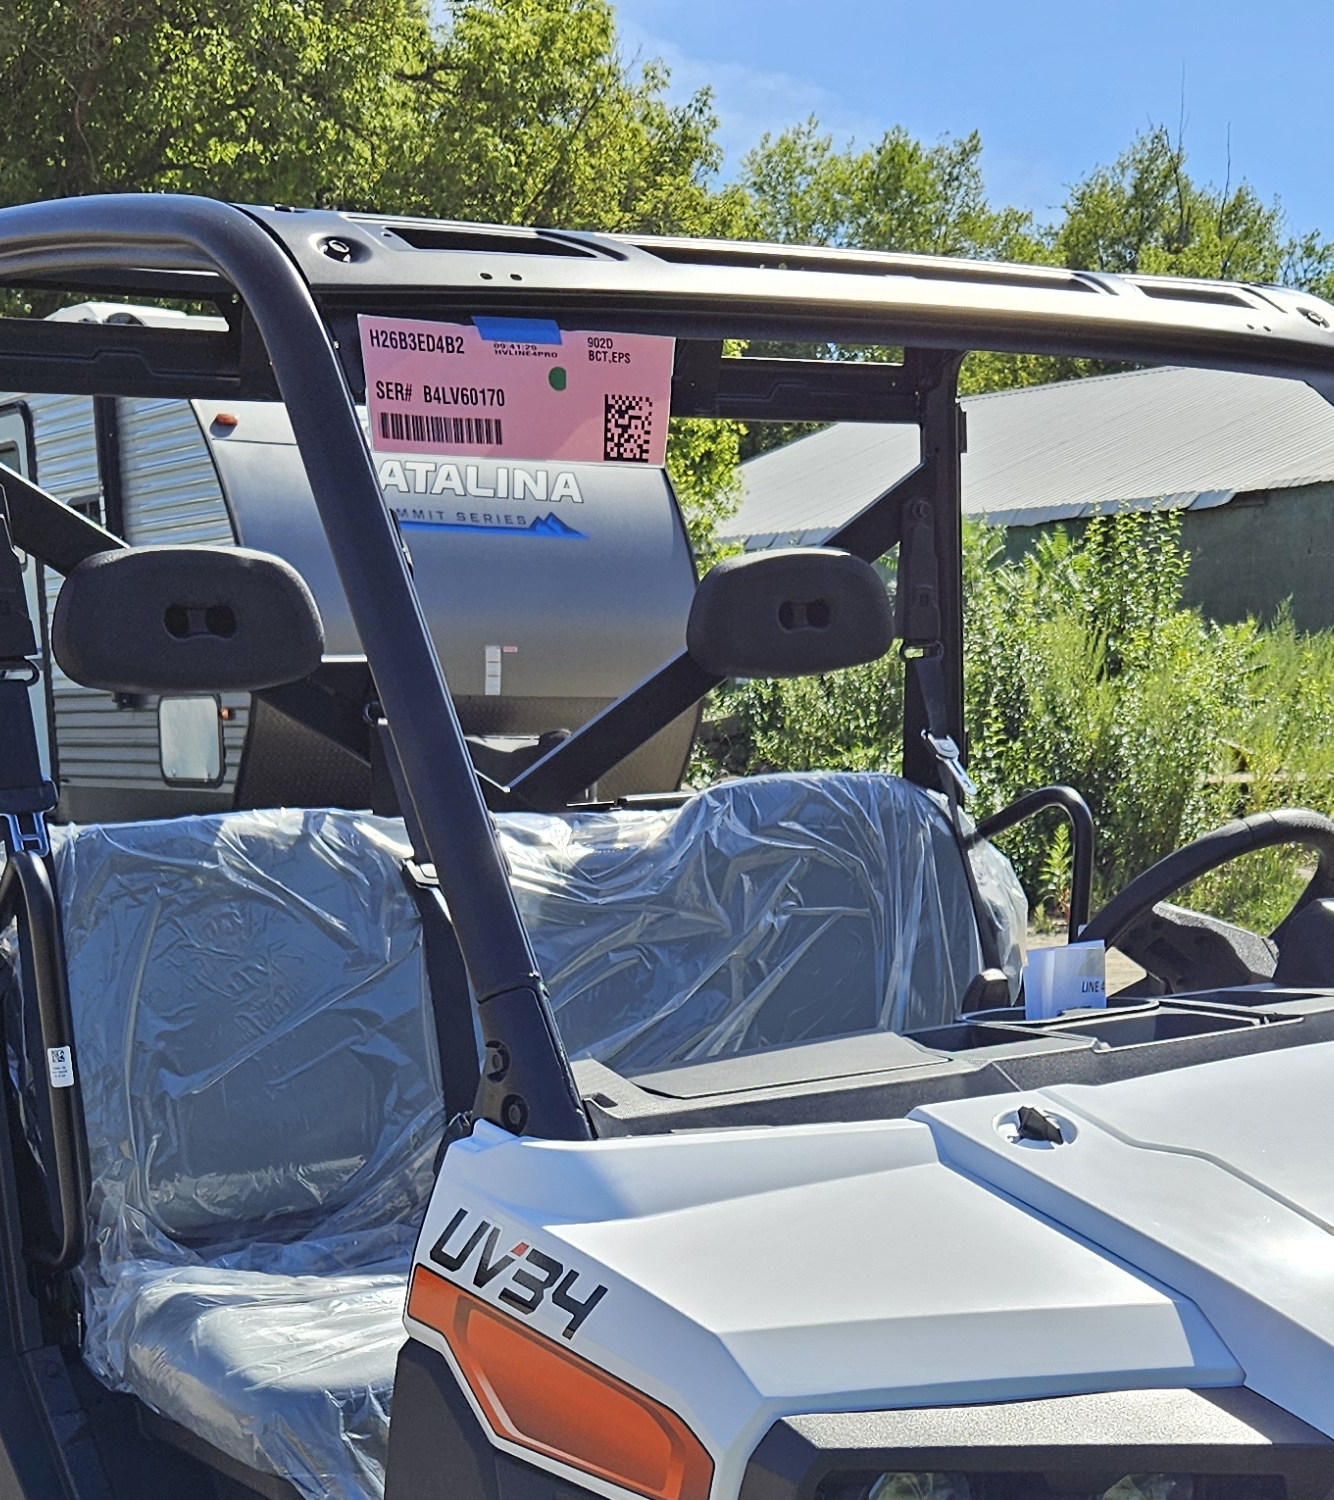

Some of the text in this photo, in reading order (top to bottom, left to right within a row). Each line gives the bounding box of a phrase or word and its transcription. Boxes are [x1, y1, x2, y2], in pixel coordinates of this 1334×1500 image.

[369, 329, 464, 354] H26B3ED4B2
[587, 337, 613, 349] 902D
[375, 381, 505, 407] SER# B4LV60170
[378, 461, 583, 503] ATALINA
[396, 508, 527, 525] MMIT SERIES
[1081, 981, 1099, 993] LINE
[429, 1208, 609, 1340] UV34
